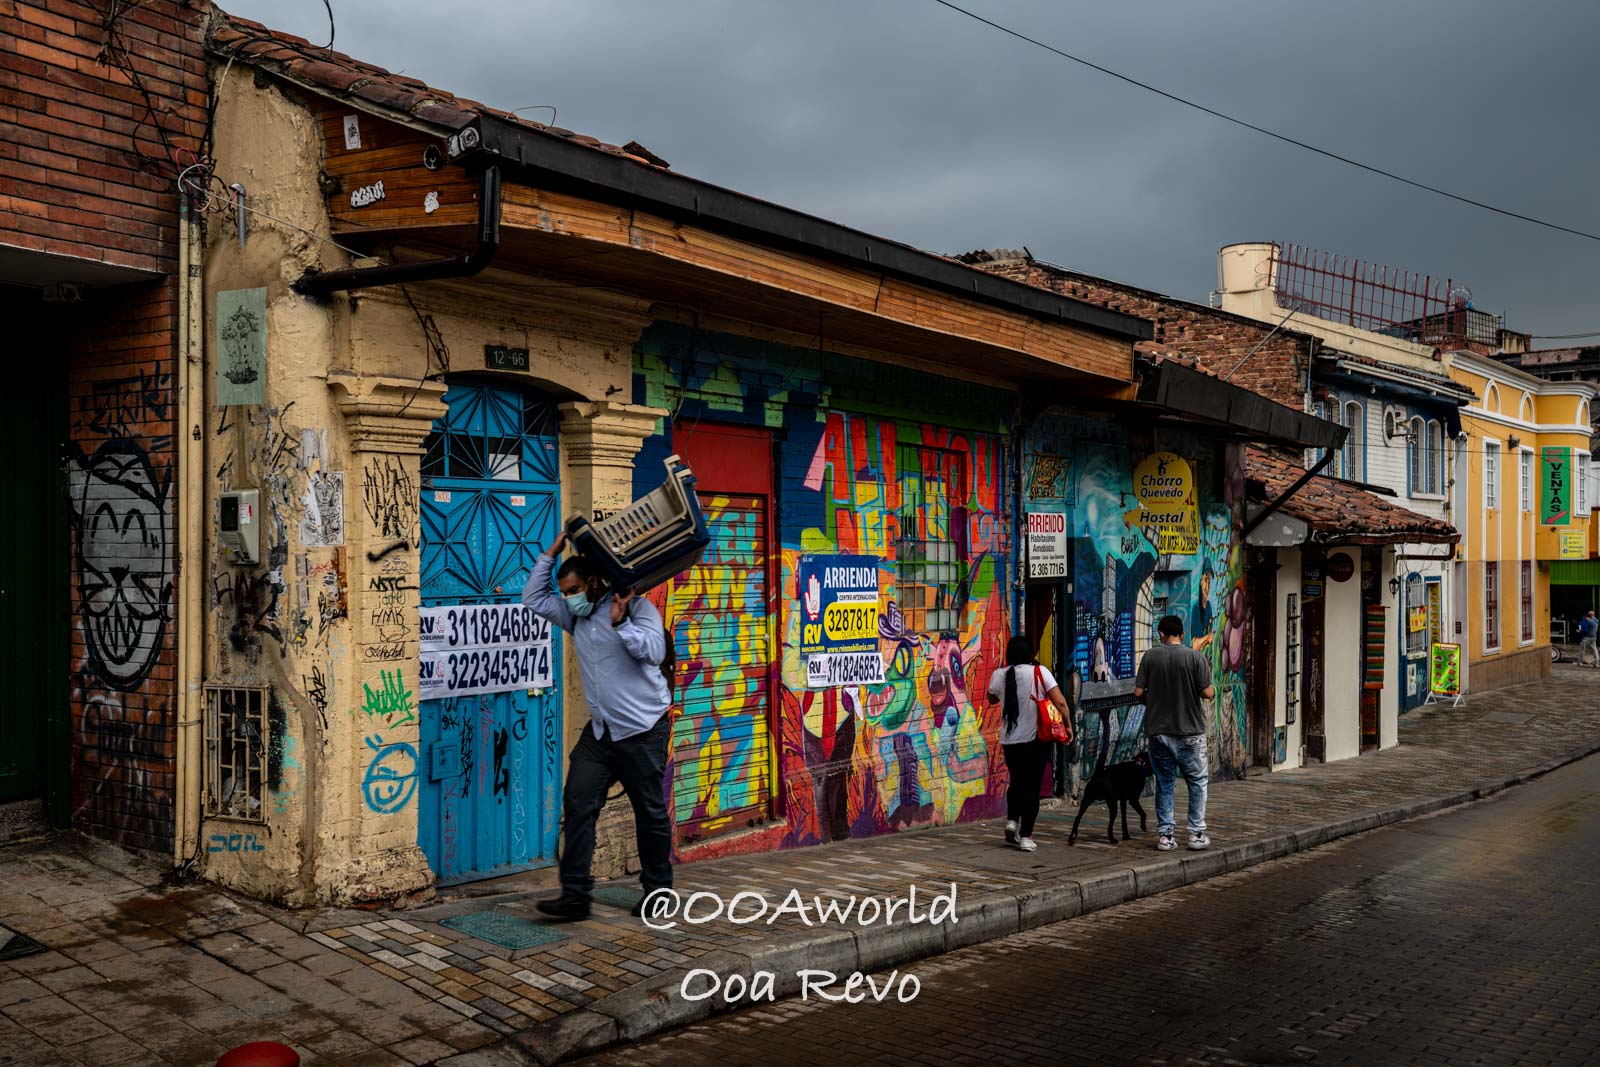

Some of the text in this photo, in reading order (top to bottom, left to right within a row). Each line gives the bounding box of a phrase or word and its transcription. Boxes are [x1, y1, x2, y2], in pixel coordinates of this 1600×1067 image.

[919, 422, 1001, 513] YOU
[1141, 475, 1183, 486] Chorro
[1550, 462, 1563, 513] VENTAS
[1140, 488, 1183, 499] Quevedo
[1139, 511, 1184, 523] Hostal
[823, 567, 878, 588] ARRIENDA
[447, 607, 549, 646] 3118246852
[828, 608, 877, 632] 3287817
[803, 623, 823, 645] RV
[447, 646, 549, 690] 3223453474
[809, 661, 822, 674] RV
[827, 654, 883, 683] 3118246852
